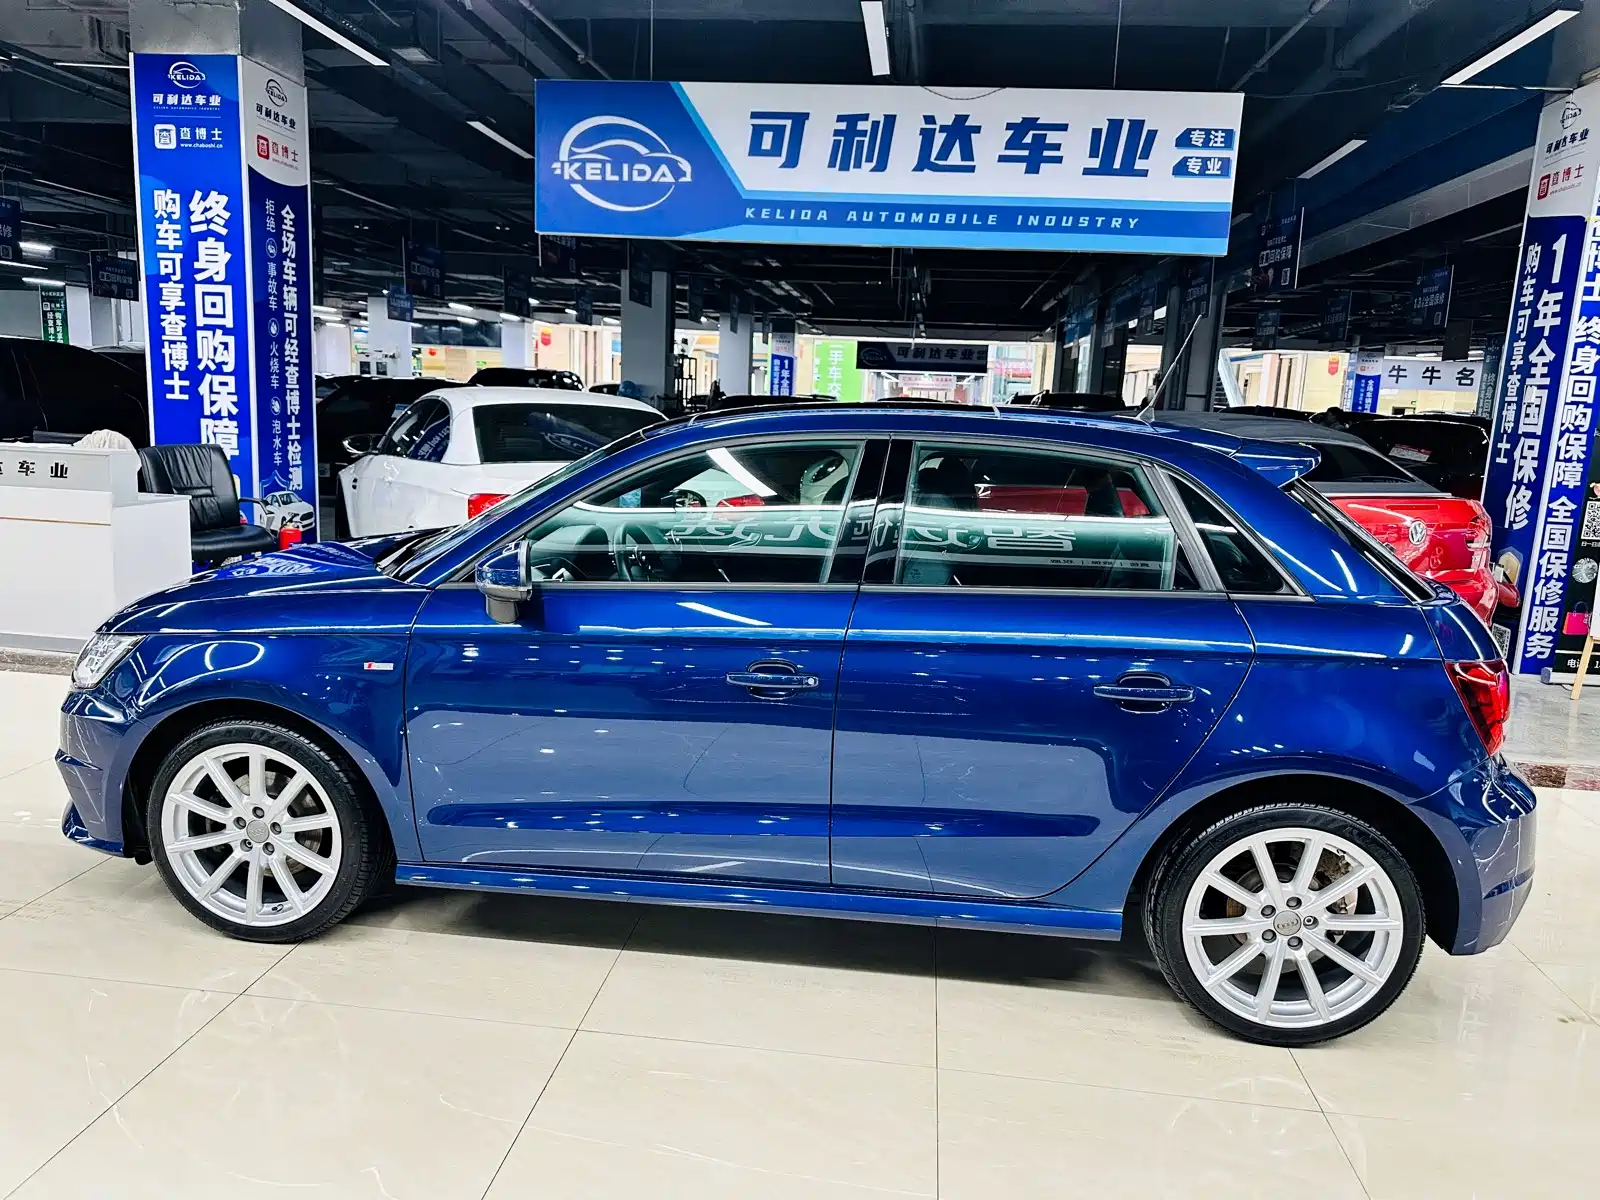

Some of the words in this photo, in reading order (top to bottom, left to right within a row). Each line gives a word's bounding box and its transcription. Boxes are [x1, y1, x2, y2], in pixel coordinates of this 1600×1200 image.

[152, 93, 221, 106] 可利达车业
[179, 127, 223, 141] 查博士
[271, 141, 299, 162] 查博士
[747, 111, 1158, 177] 可利达车业
[1189, 129, 1226, 148] 专注
[563, 161, 676, 183] KELIDA
[1186, 157, 1222, 175] 专业
[265, 198, 276, 233] 拒绝
[745, 207, 829, 221] KELIDA
[847, 209, 998, 225] AUTOMOBILE
[1016, 214, 1141, 229] INDUSTRY
[153, 188, 190, 400] 购车可享查博士
[188, 188, 240, 461] 终身回购保障
[281, 204, 303, 491] 全场车辆可经查博士检测
[1495, 242, 1542, 464] 购车可享查博士
[269, 341, 280, 390] 火烧车
[1388, 364, 1475, 387] 牛牛名
[1504, 233, 1568, 530] 1年全国保修
[271, 419, 283, 467] 泡水车
[0, 460, 69, 479] 车业
[1524, 495, 1578, 659] 全国保修服务
